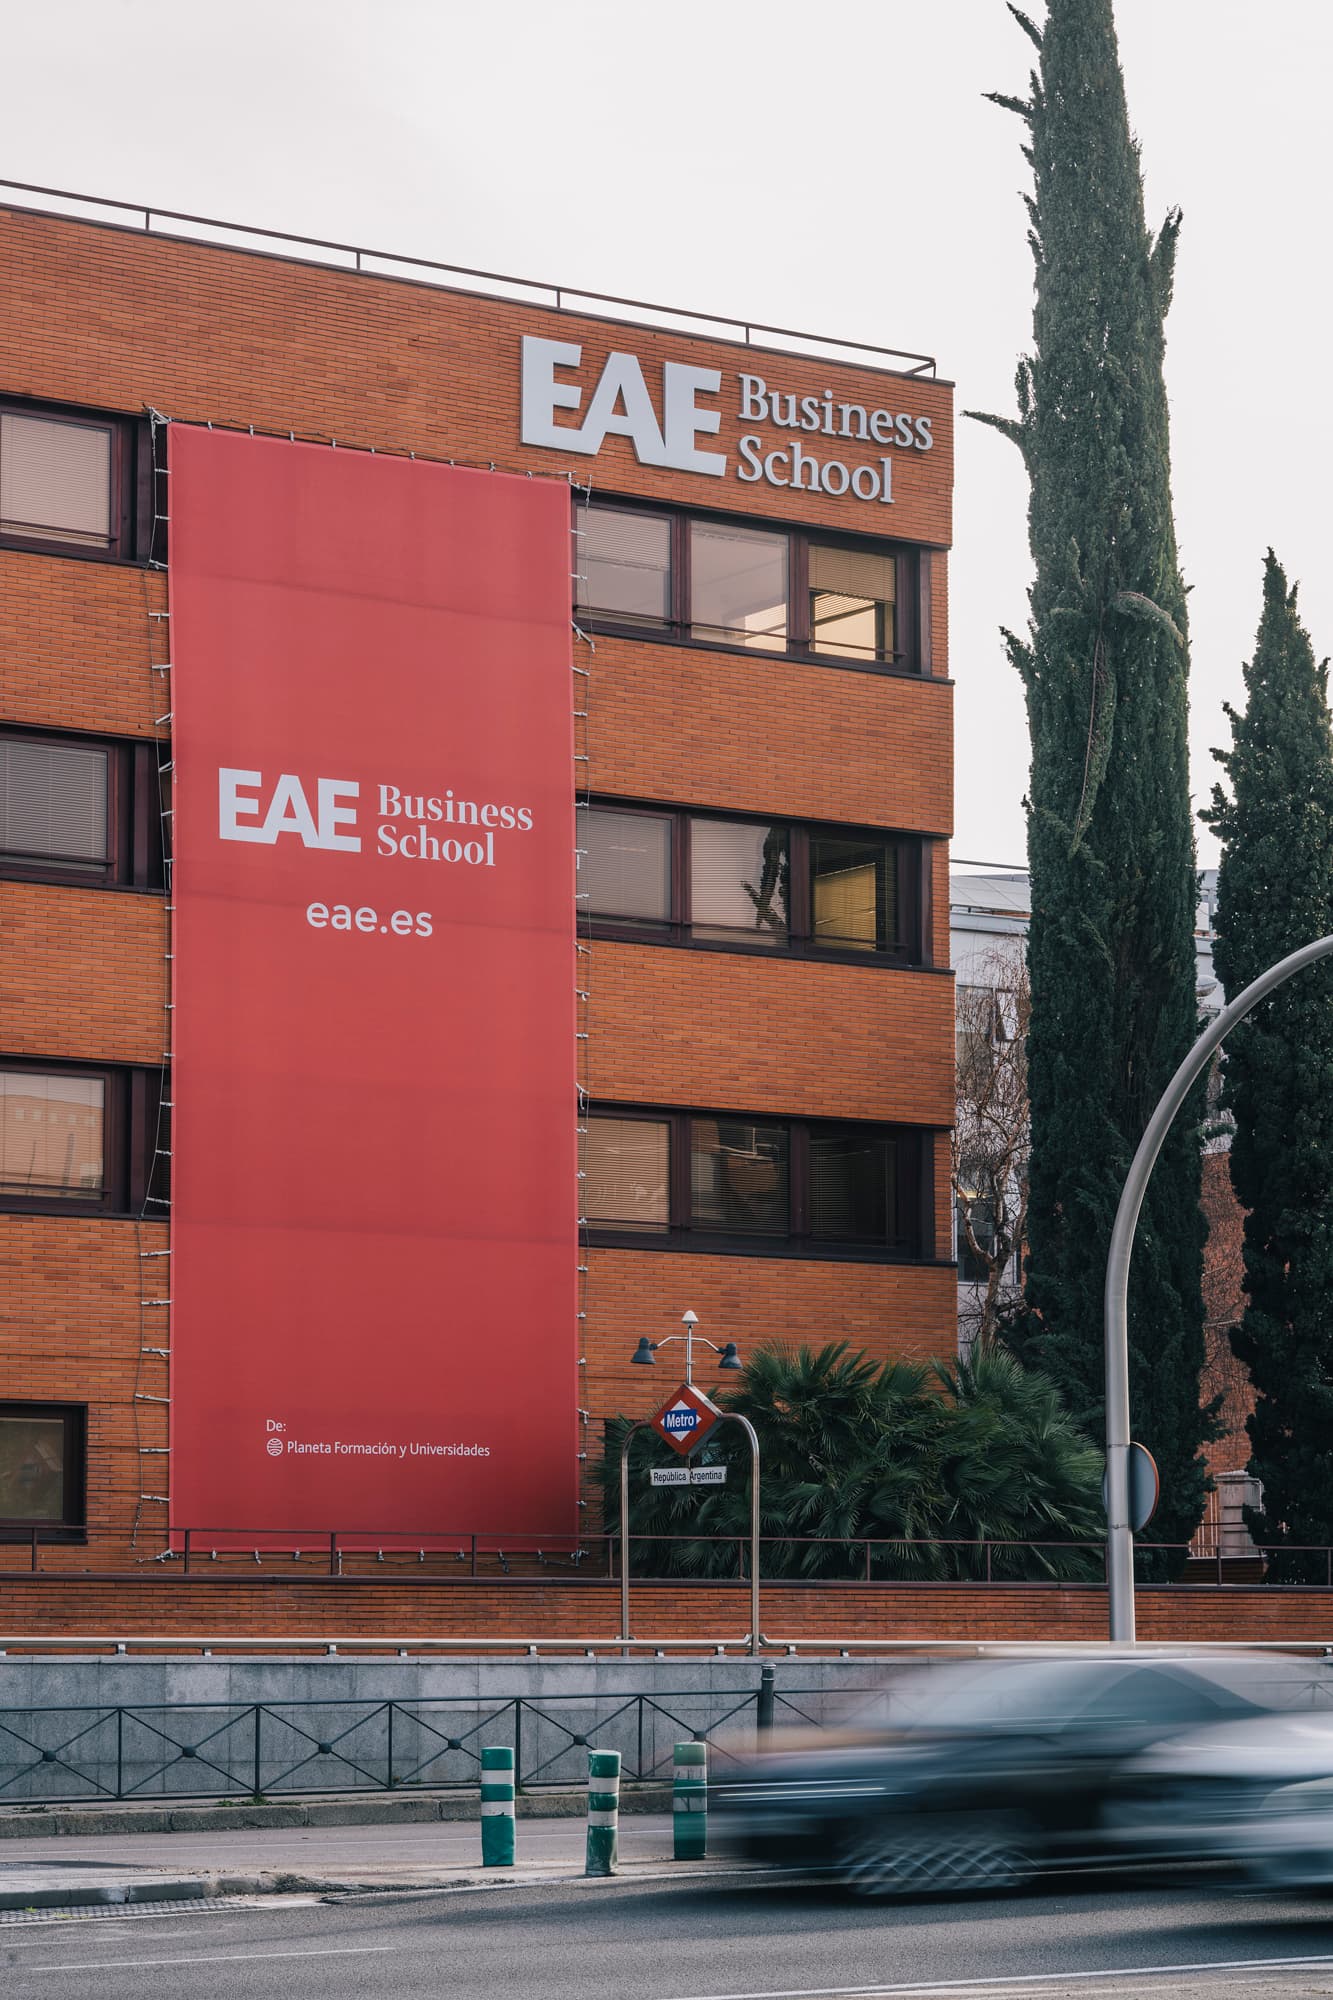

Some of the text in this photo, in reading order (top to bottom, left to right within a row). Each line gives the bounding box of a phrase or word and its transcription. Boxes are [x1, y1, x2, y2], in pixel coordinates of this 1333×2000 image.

[521, 335, 727, 477] EAE
[738, 373, 935, 451] Business
[737, 434, 896, 504] School
[218, 767, 362, 853] EAE
[377, 784, 534, 831] Business
[377, 824, 496, 867] School
[306, 902, 434, 937] eae.es
[266, 1419, 287, 1432] De:
[666, 1414, 694, 1428] Metro
[287, 1440, 490, 1459] Planeta Formación y Universidades
[653, 1470, 722, 1483] República Argentina
